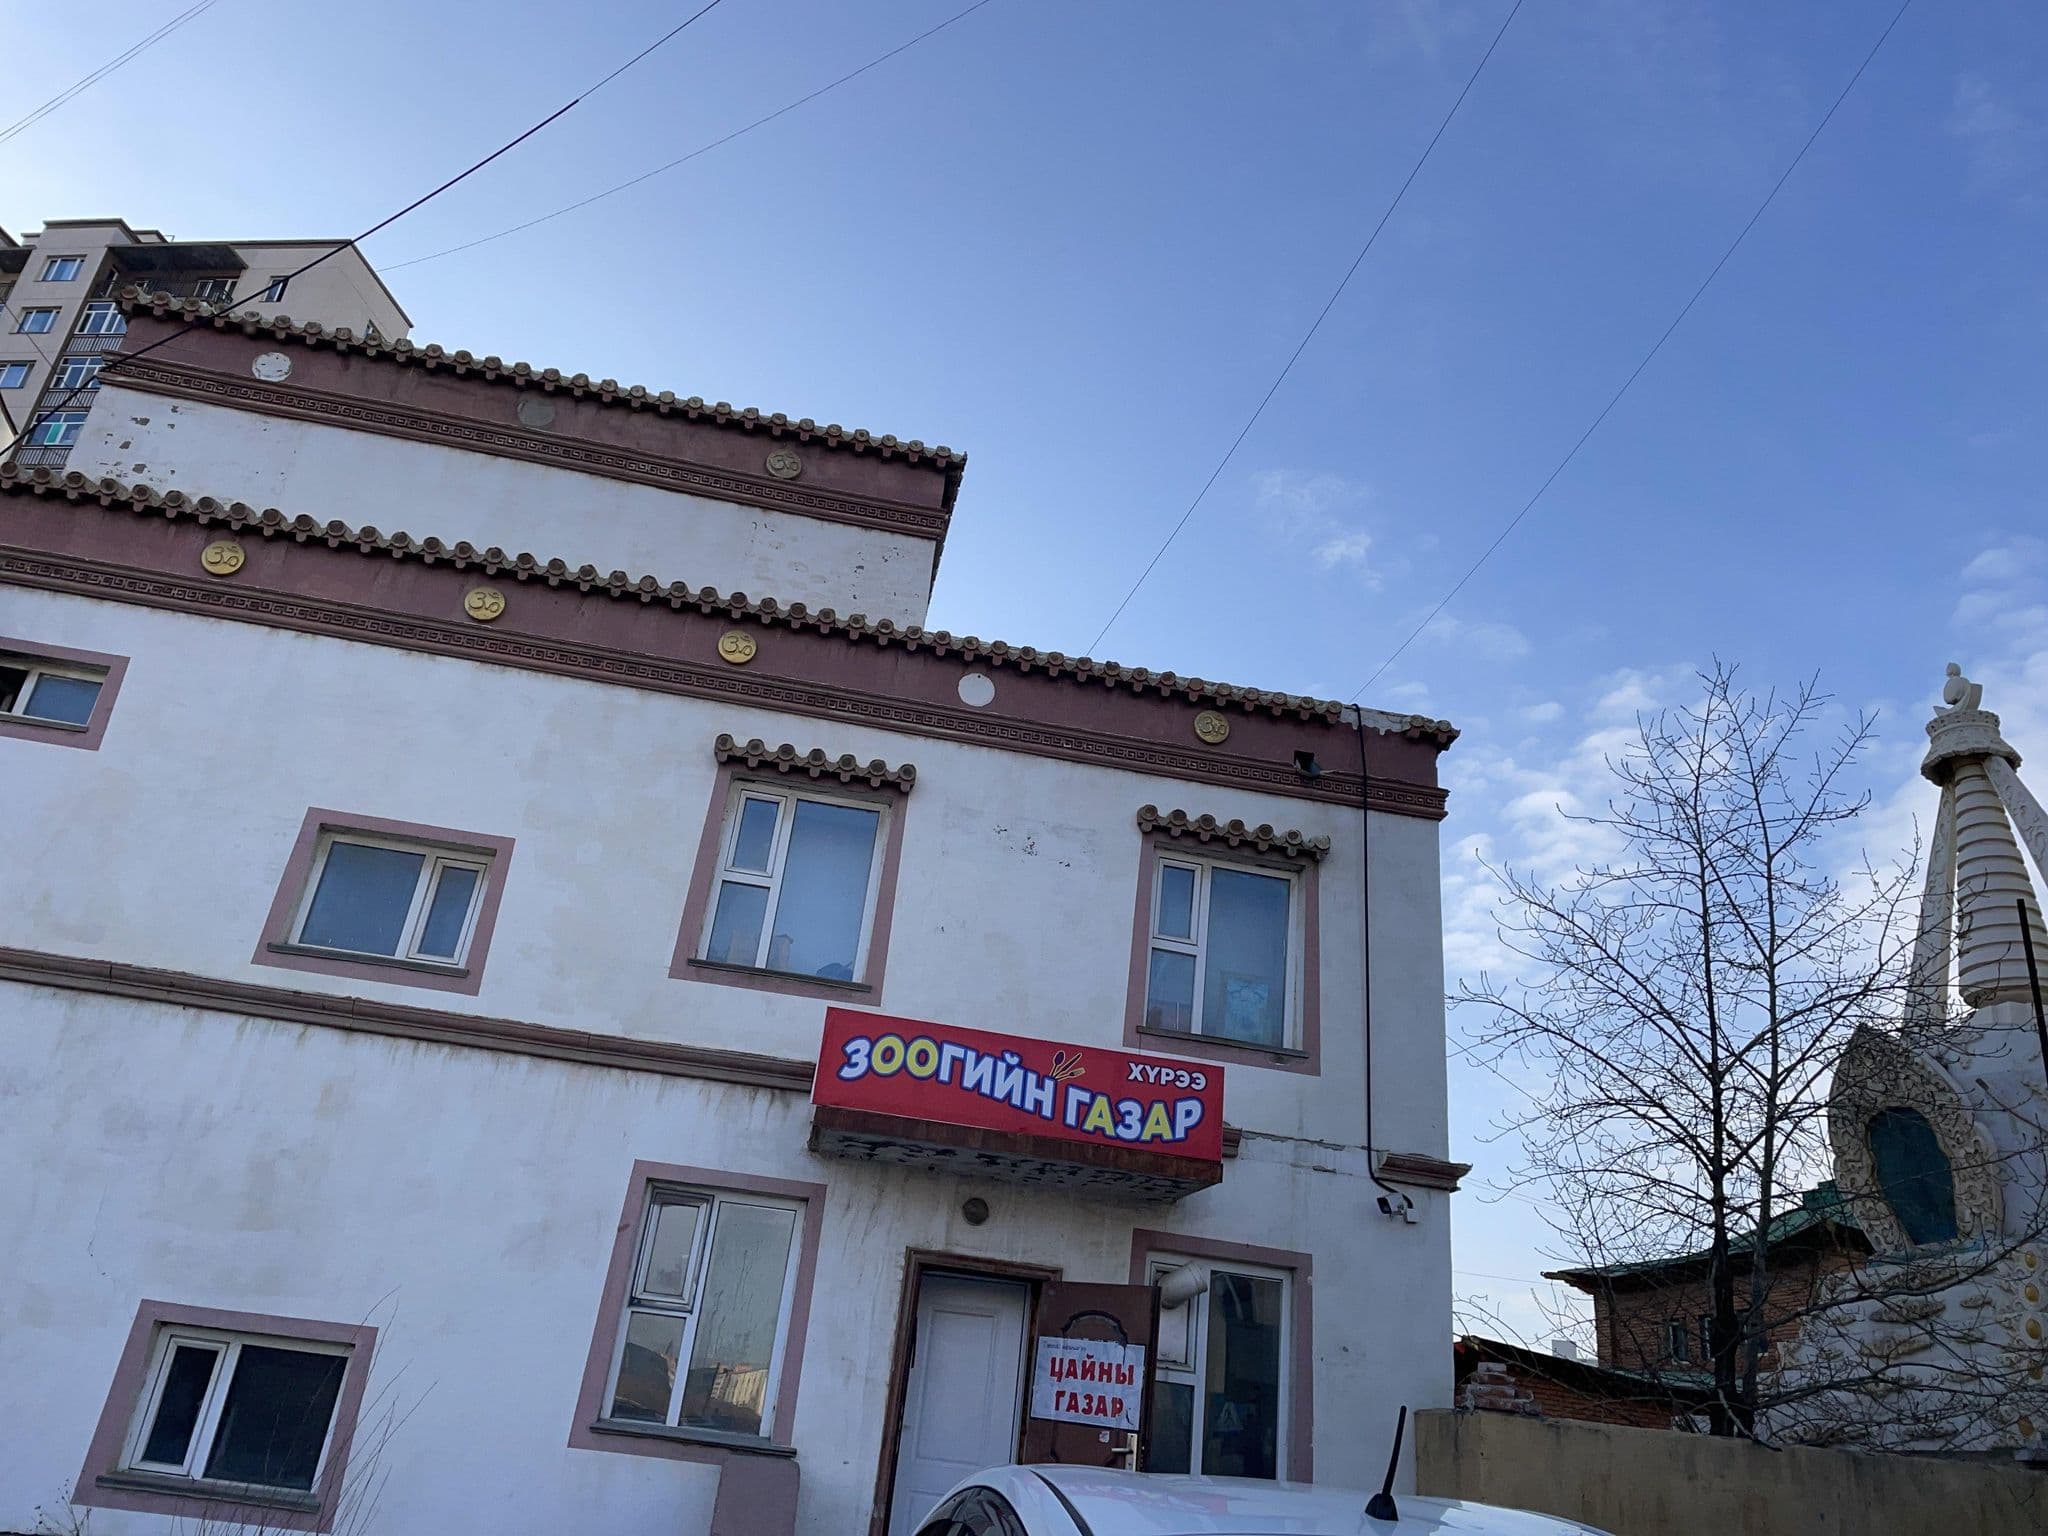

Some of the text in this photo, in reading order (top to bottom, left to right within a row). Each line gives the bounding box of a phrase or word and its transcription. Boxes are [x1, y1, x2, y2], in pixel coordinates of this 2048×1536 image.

[837, 1034, 1203, 1141] ЗООГИЙН ГАЗАР
[1127, 1061, 1207, 1091] ХҮРЭЭ
[1049, 1353, 1134, 1386] ЦАЙНЫ
[1054, 1390, 1124, 1418] ГАЗАР
